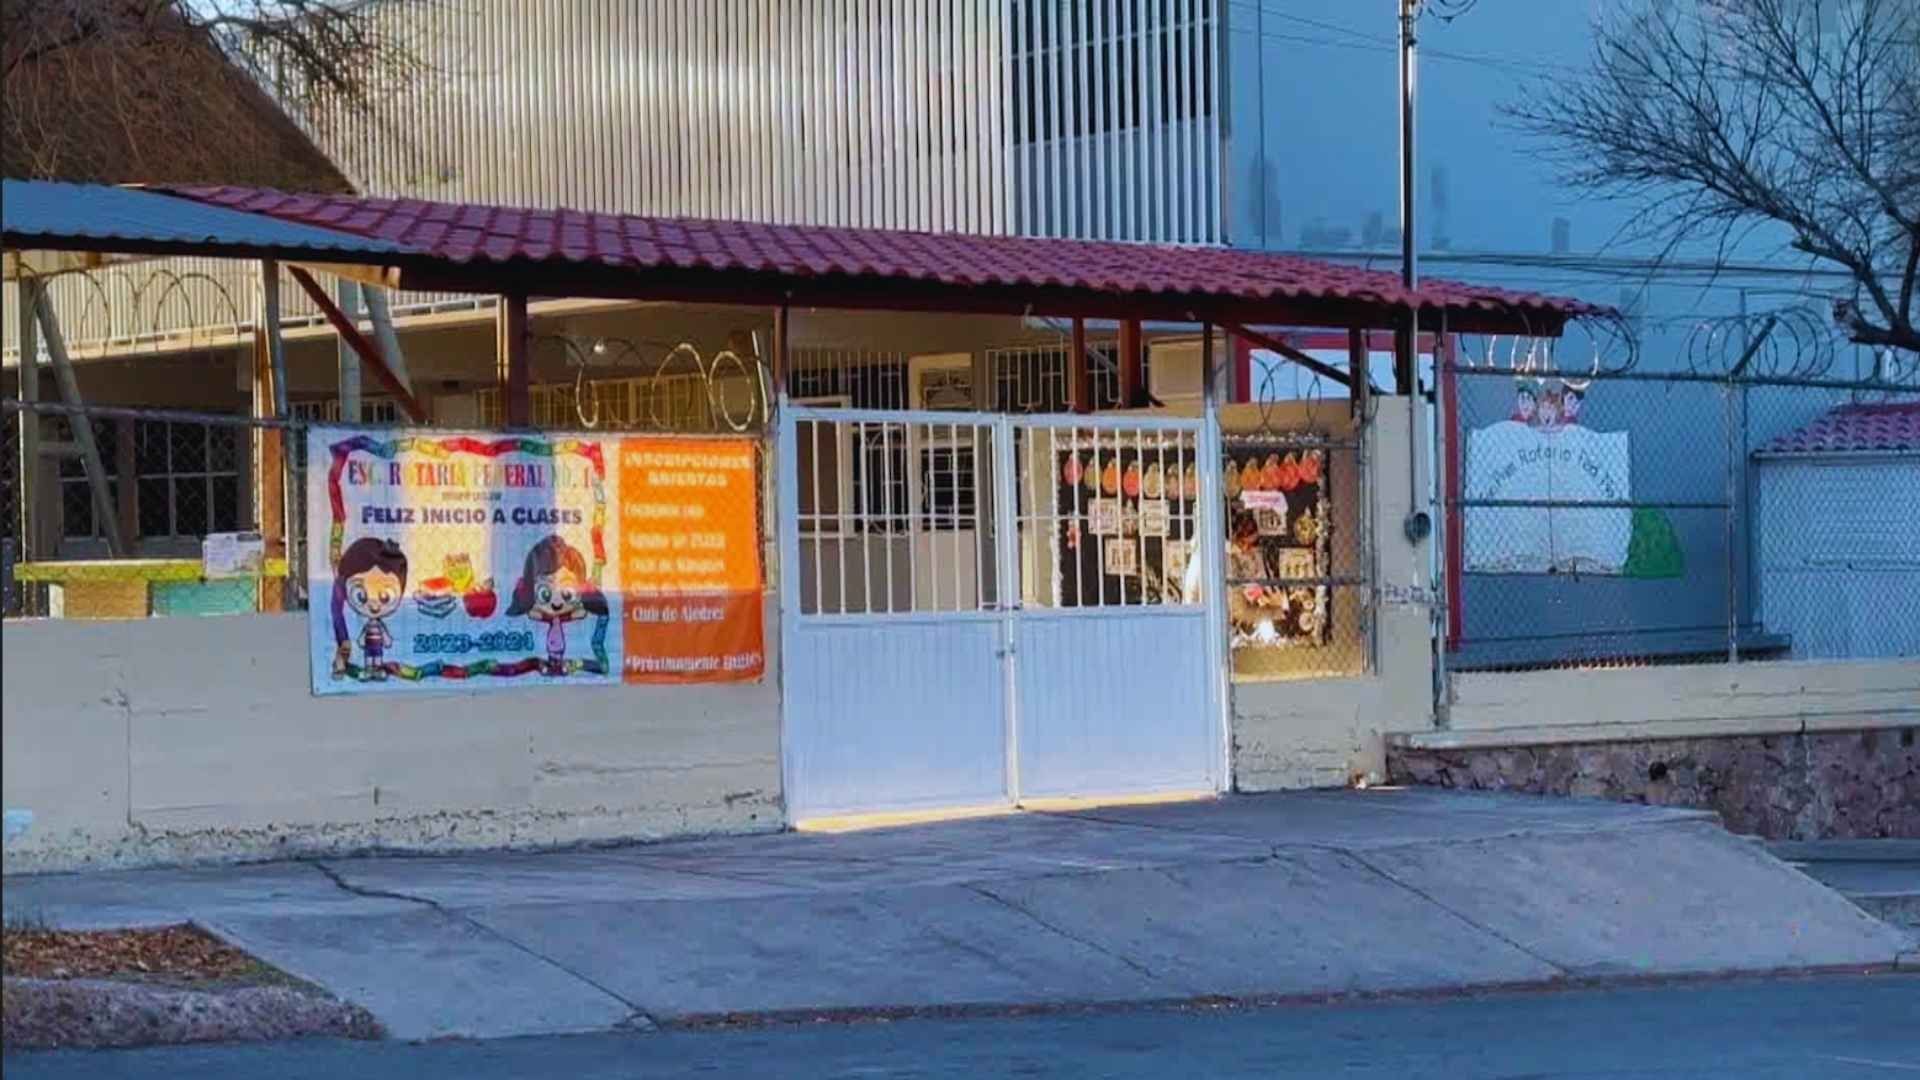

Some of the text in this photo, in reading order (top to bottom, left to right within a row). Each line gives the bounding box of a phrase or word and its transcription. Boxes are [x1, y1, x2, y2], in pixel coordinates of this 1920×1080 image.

[1517, 445, 1572, 466] Rotario
[361, 504, 583, 526] FELIZ INICIO A CLASES
[661, 605, 679, 623] de
